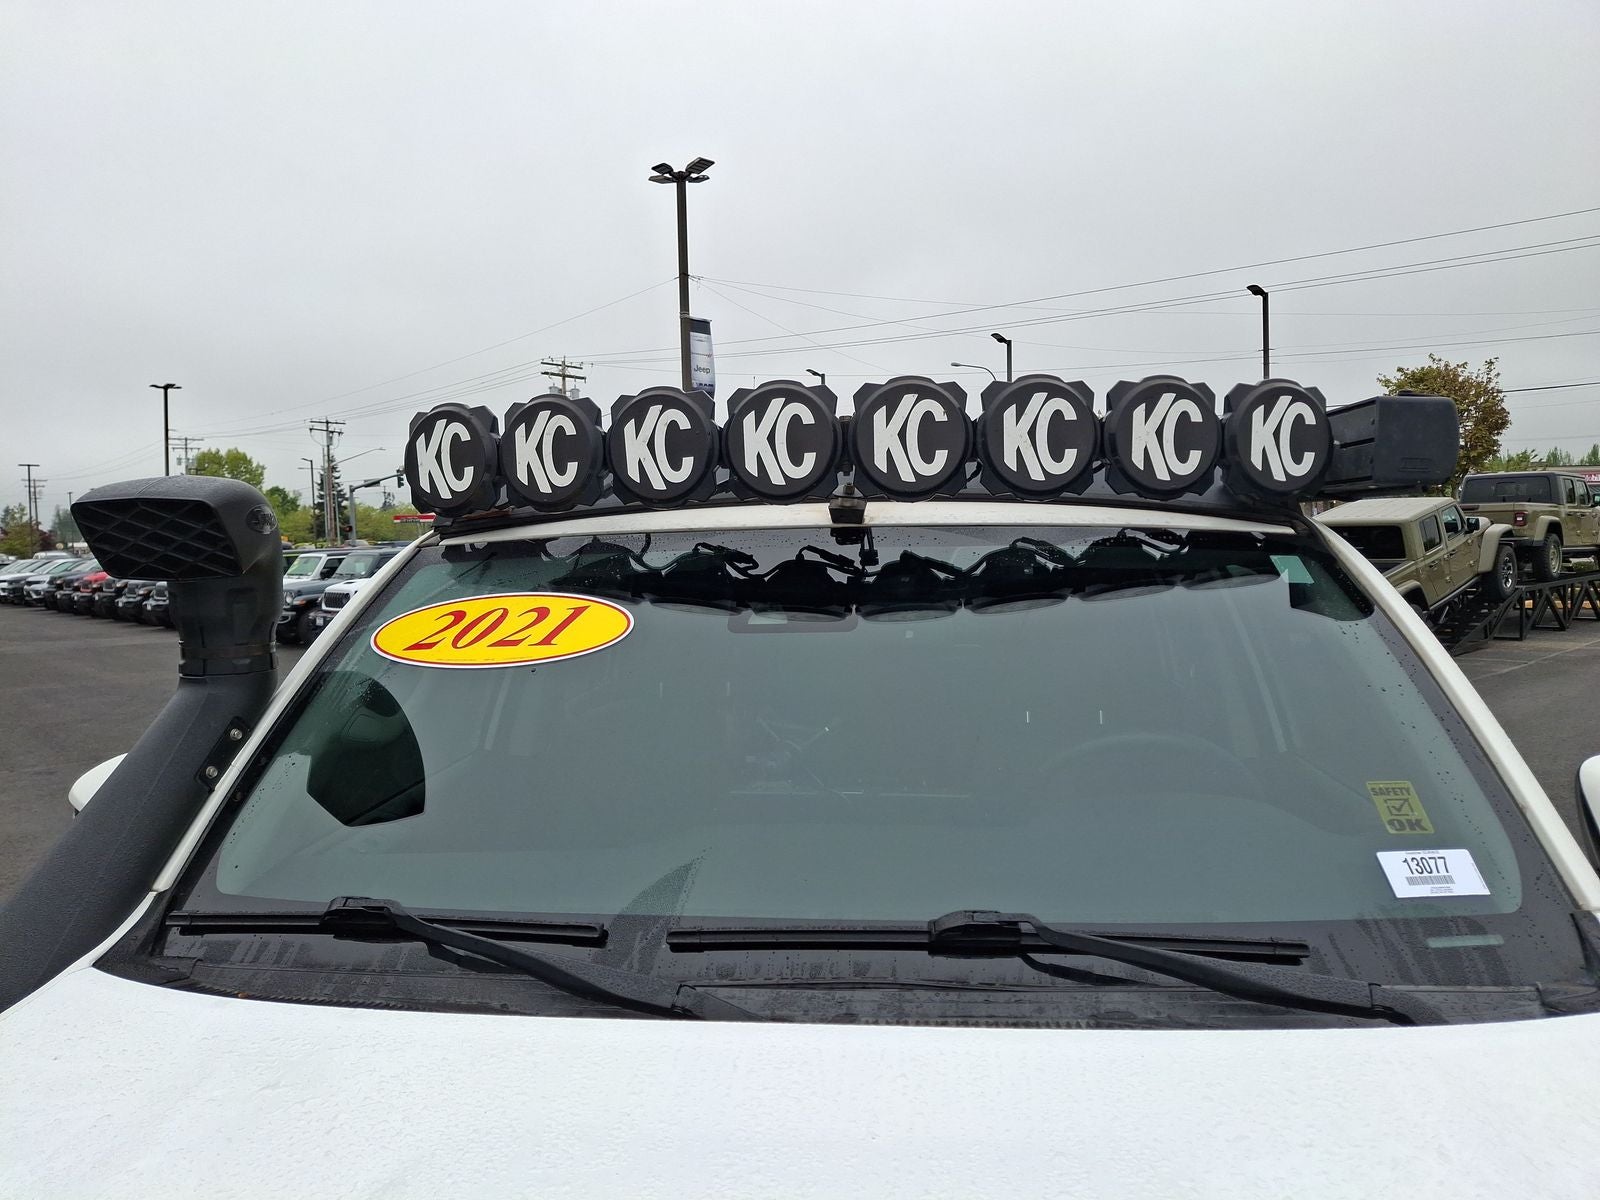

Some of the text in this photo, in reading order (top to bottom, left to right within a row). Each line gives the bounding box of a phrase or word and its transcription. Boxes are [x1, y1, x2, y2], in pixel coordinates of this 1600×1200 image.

[694, 364, 711, 375] Jeep
[416, 418, 474, 499] KC
[515, 411, 578, 493] KC
[624, 405, 694, 490] KC
[743, 398, 816, 485] KC
[874, 394, 948, 482] KC
[1004, 392, 1077, 480] KC
[1132, 393, 1202, 480] KC
[1251, 396, 1316, 481] KC
[402, 604, 592, 652] 2021
[1371, 786, 1412, 796] SAFETY
[1387, 818, 1428, 832] OK
[1402, 856, 1450, 875] 13077
